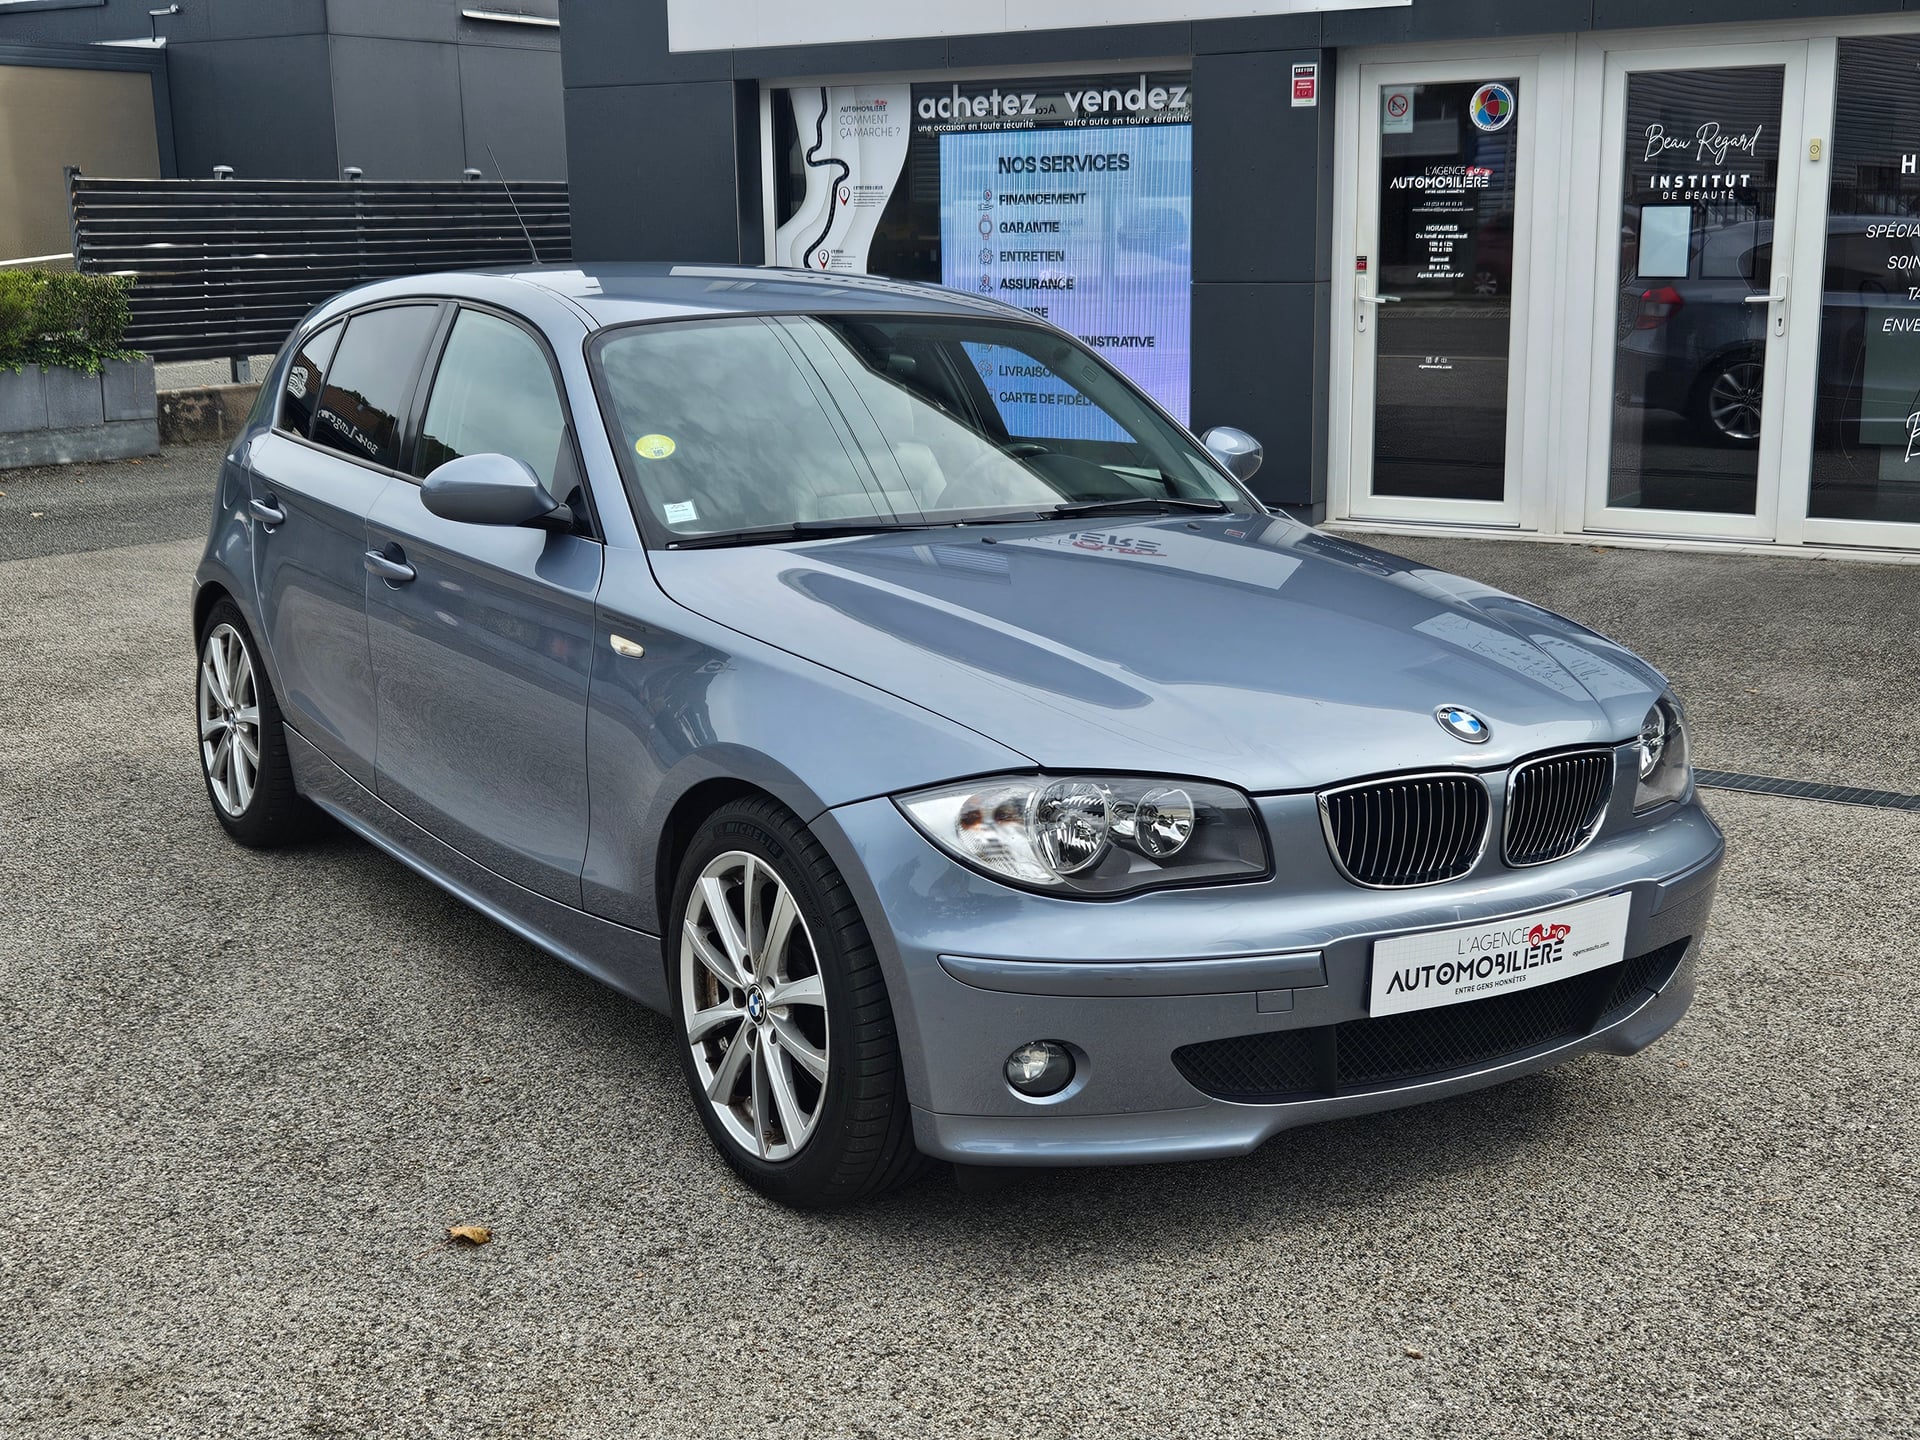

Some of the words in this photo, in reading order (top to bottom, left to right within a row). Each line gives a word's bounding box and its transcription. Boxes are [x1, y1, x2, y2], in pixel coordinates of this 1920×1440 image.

[1064, 74, 1188, 113] vendez
[918, 84, 1037, 119] achetez
[840, 114, 888, 126] COMMENT
[934, 122, 965, 131] occasion
[980, 121, 1000, 130] toute
[1064, 117, 1086, 127] votre
[1090, 118, 1109, 126] auto
[1126, 116, 1150, 125] toute
[840, 127, 852, 139] ÇA
[854, 127, 893, 138] MARCHE
[1644, 124, 1690, 162] Beau
[1696, 122, 1762, 166] Regard
[998, 155, 1037, 174] NOS
[1040, 153, 1130, 174] SERVICES
[1425, 166, 1466, 176] L'AGENCE
[1650, 174, 1751, 189] INSTITUT
[1000, 193, 1086, 206] FINANCEMENT
[1662, 191, 1678, 200] DE
[1685, 189, 1735, 200] BEAUTÉ
[1000, 221, 1060, 233] GARANTIE
[1000, 250, 1064, 262] ENTRETIEN
[1000, 278, 1074, 290] ASSURANCE
[999, 391, 1038, 403] CARTE
[1039, 393, 1055, 404] DE
[1457, 926, 1530, 955] L'AGENCE
[1455, 984, 1475, 995] ENTRE
[1476, 982, 1494, 991] GENS
